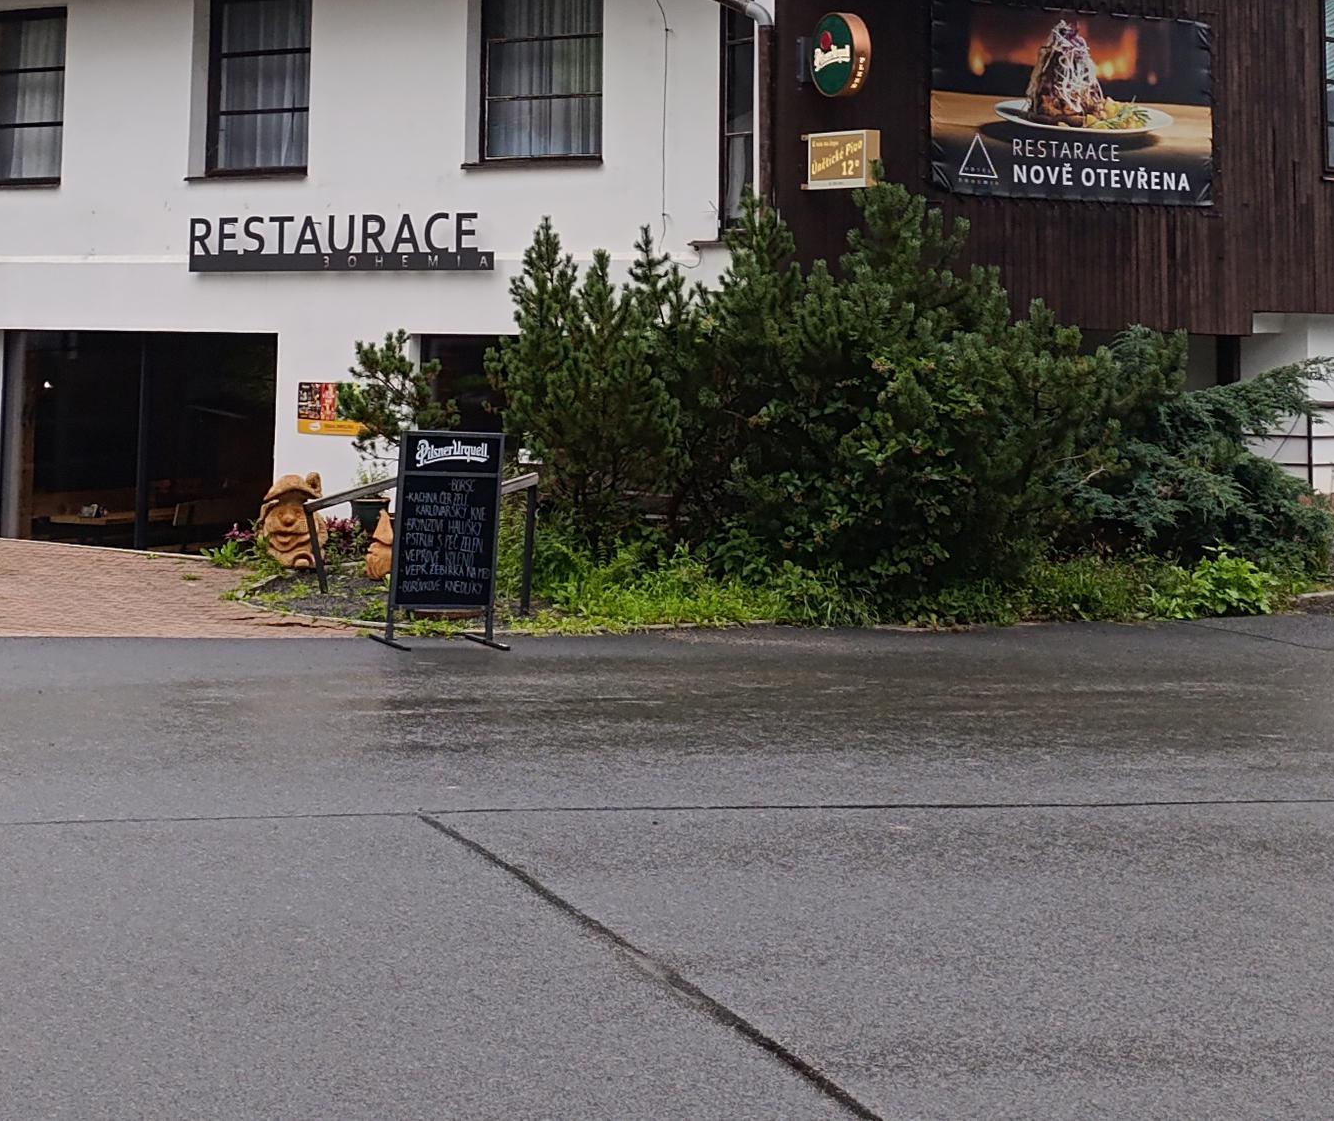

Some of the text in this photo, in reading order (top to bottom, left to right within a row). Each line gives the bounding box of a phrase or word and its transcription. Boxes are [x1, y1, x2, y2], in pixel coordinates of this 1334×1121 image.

[845, 139, 863, 156] Pivo
[1012, 138, 1120, 162] RESTARACE
[841, 159, 860, 176] 12°
[1013, 163, 1191, 191] NOVĚ OTEVŘENA
[189, 212, 479, 255] RESTAURACE
[322, 254, 490, 268] BOHEMIA
[415, 439, 454, 467] Pilsner
